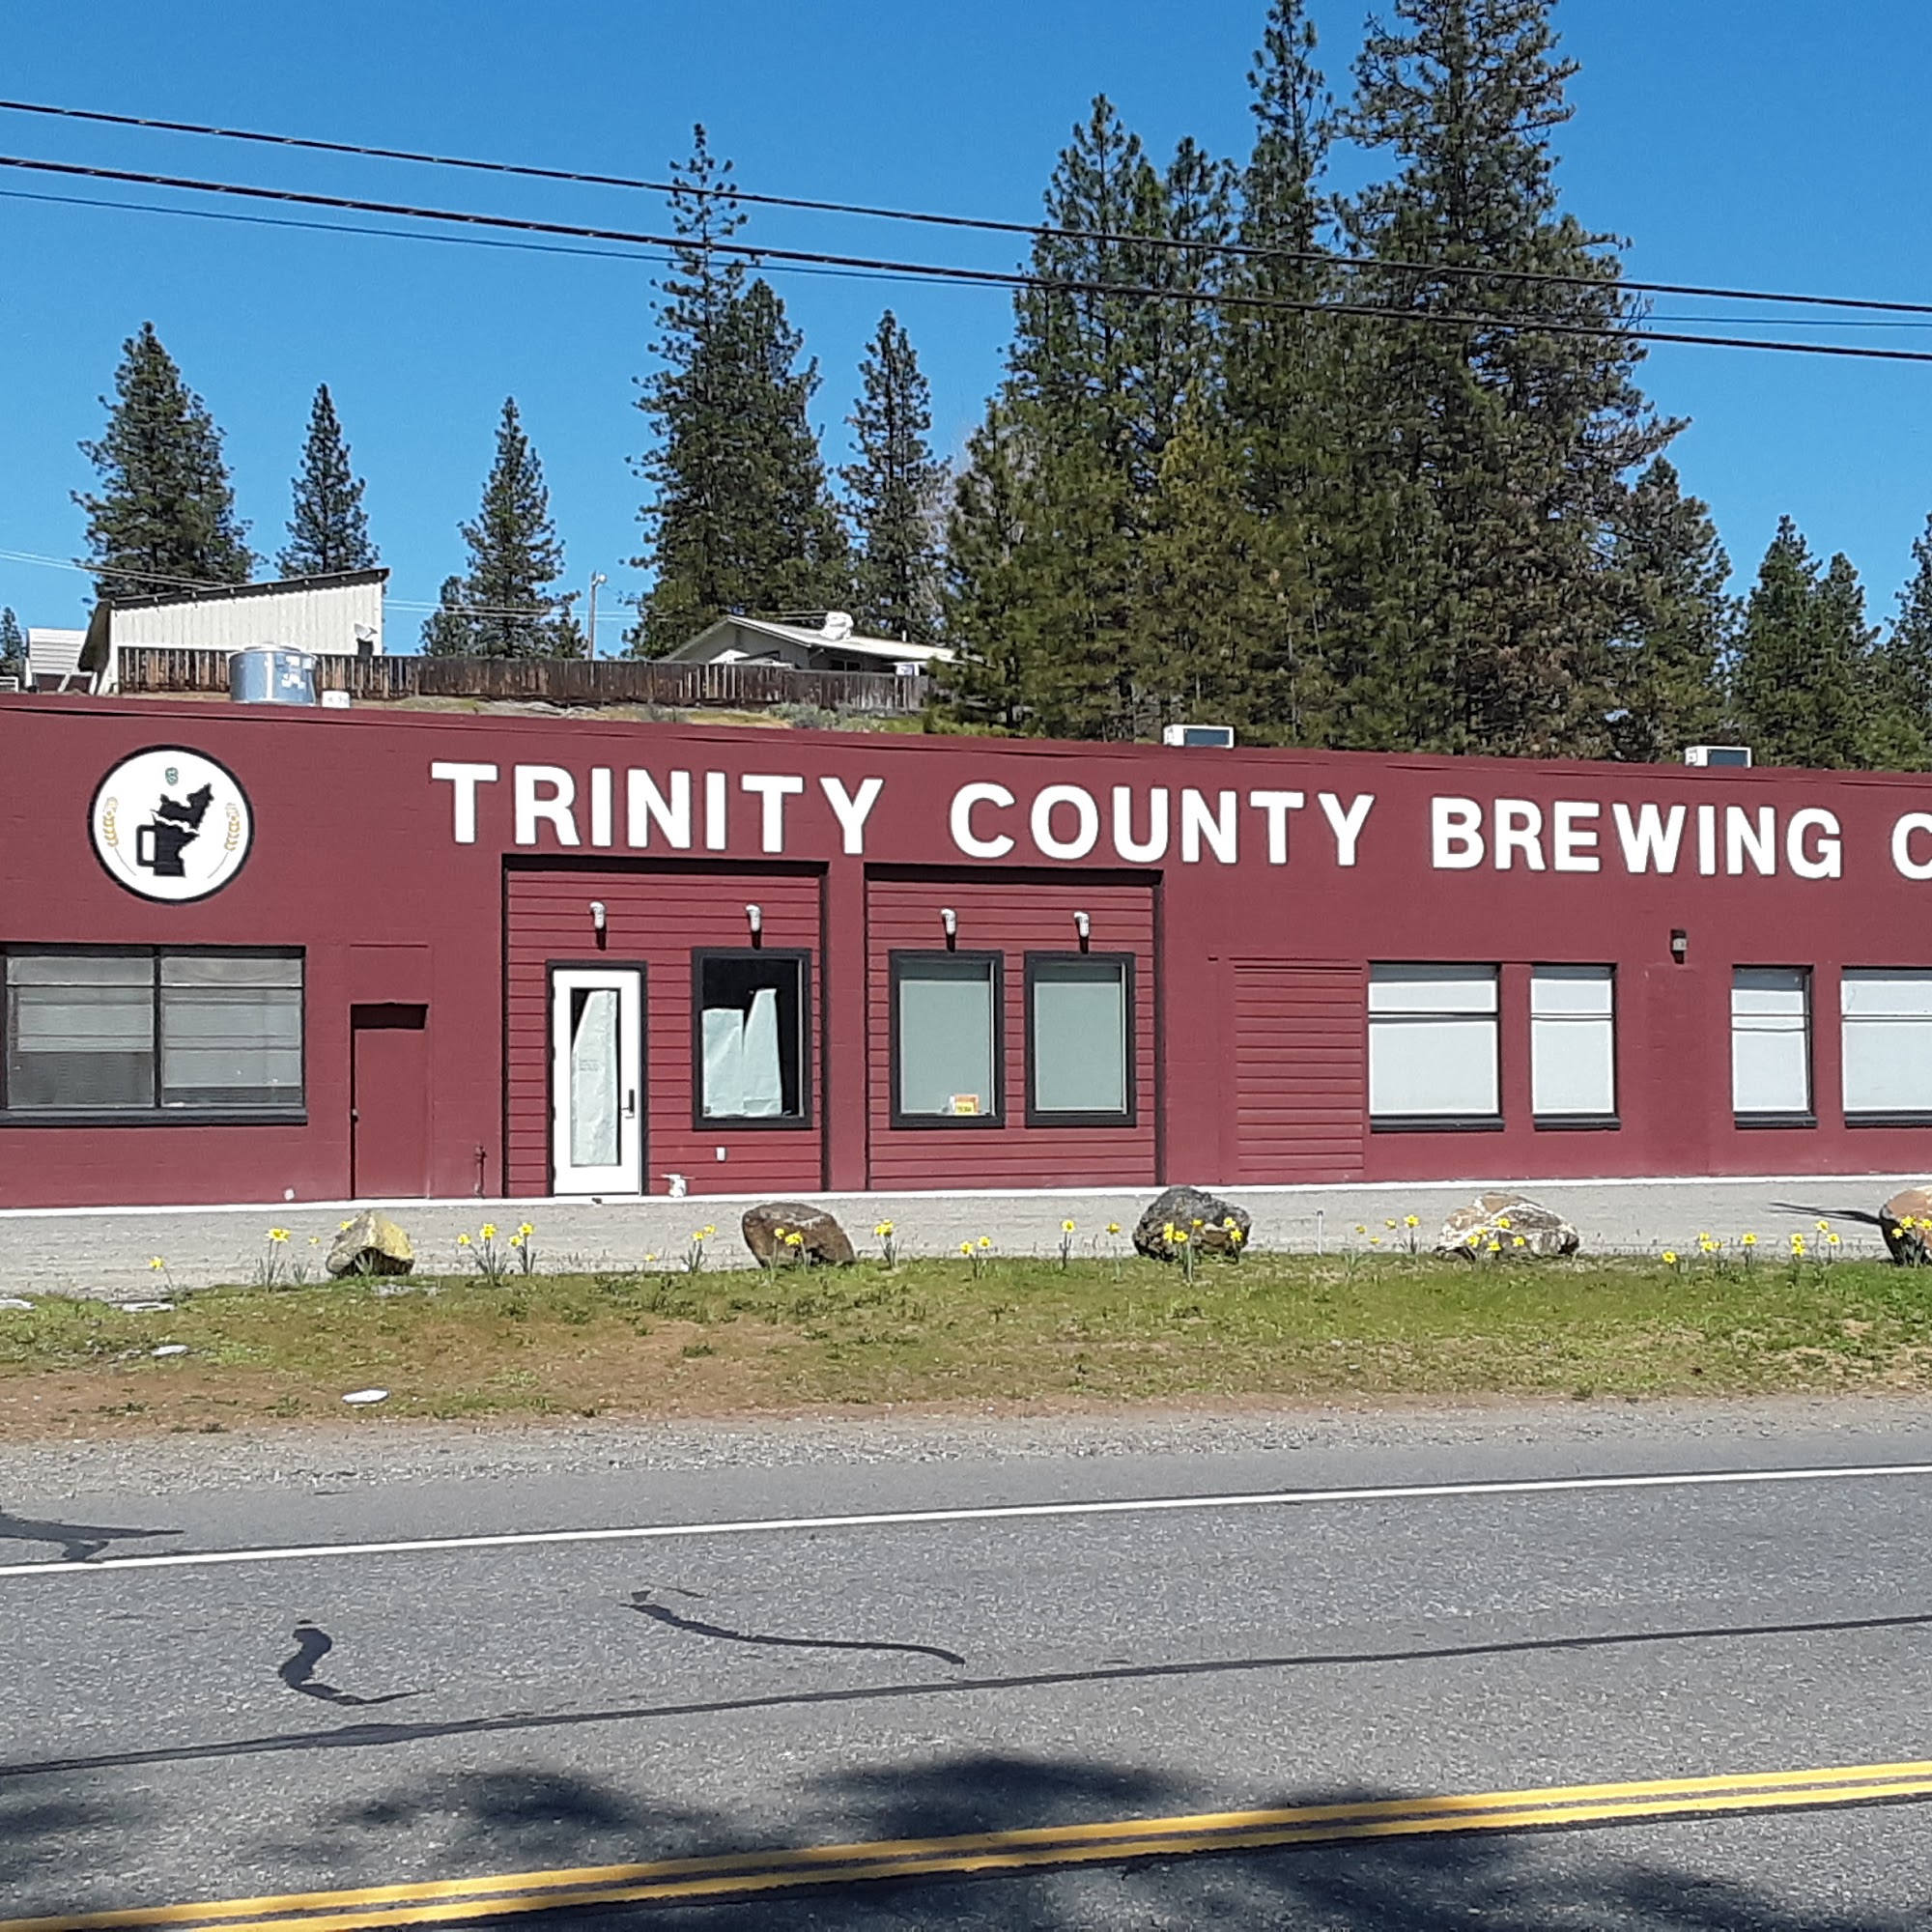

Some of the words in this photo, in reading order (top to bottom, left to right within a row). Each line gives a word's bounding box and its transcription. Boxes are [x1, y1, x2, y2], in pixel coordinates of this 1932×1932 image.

[431, 762, 884, 854] TRINITY
[951, 782, 1375, 866] COUNTY
[1432, 797, 1841, 879] BREWING
